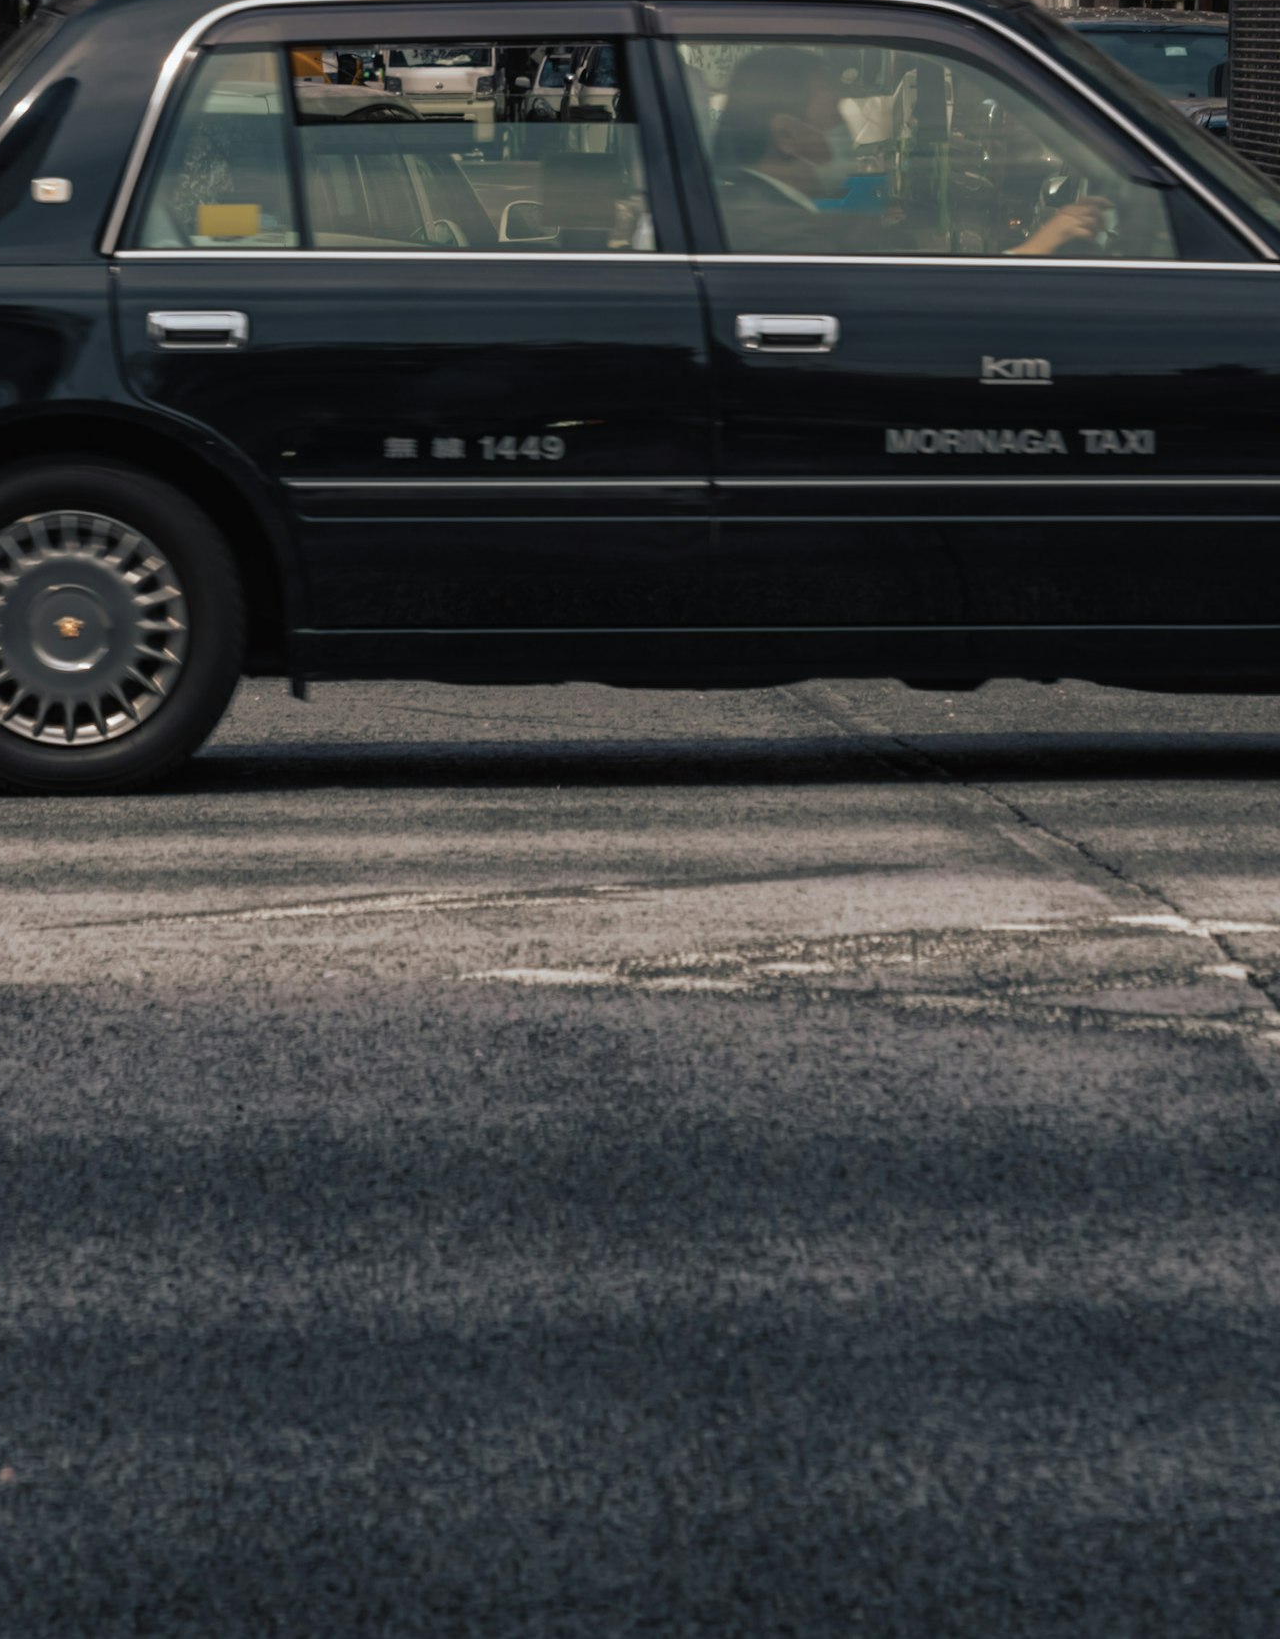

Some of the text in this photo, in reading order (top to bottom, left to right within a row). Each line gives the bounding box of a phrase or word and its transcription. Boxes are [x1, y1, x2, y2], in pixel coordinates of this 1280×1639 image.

[981, 355, 1052, 380] km
[477, 434, 567, 461] 1449
[884, 427, 1157, 455] MORINAGA TAXI
